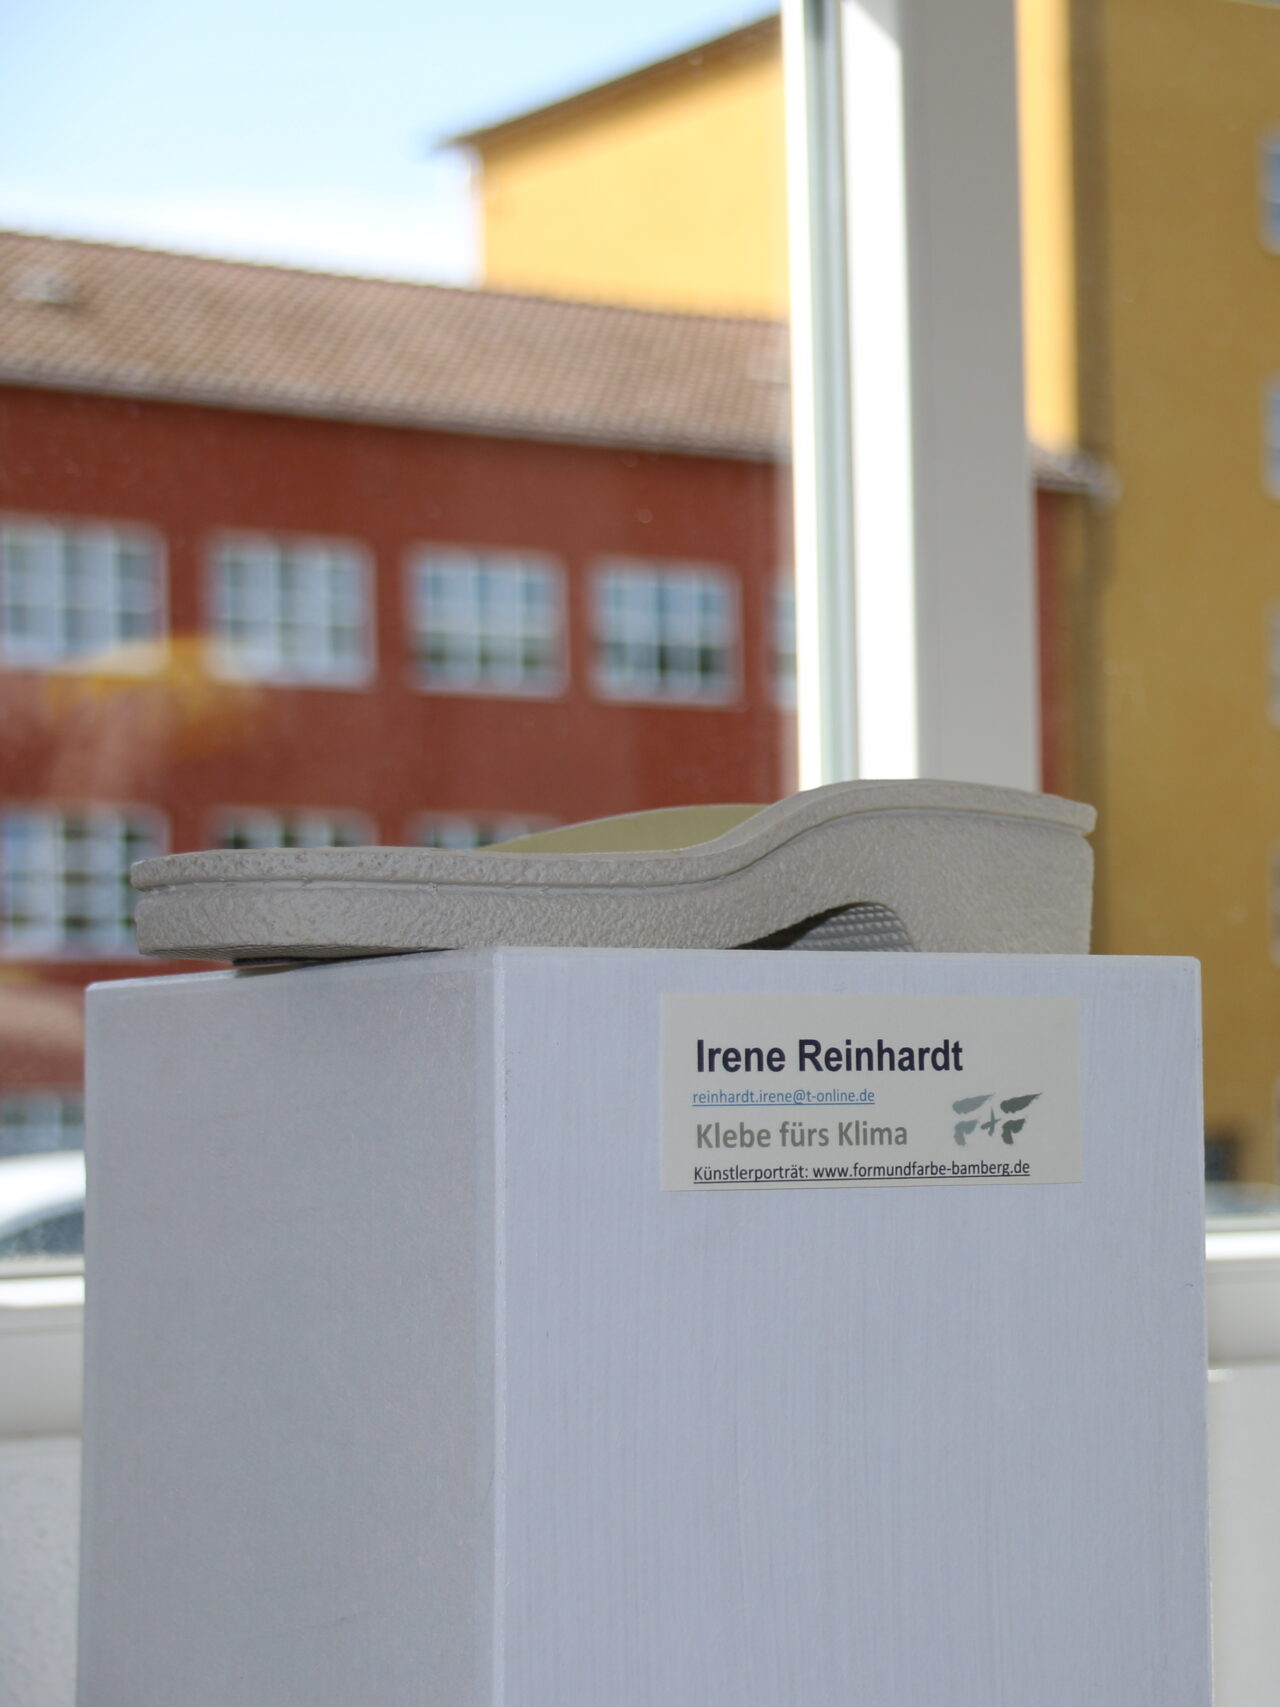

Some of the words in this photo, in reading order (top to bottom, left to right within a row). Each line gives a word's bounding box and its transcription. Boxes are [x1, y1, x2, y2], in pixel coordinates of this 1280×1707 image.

[697, 1039, 786, 1073] Irene
[798, 1039, 964, 1072] Reinhardt
[692, 1089, 875, 1106] reinhardt.irene@t-online.de
[696, 1123, 771, 1149] Klebe
[779, 1121, 829, 1147] fürs
[838, 1121, 908, 1147] Klima
[694, 1164, 809, 1183] Künstlerporträt:
[812, 1160, 1031, 1179] www.formundfarbe-bamberg.de
